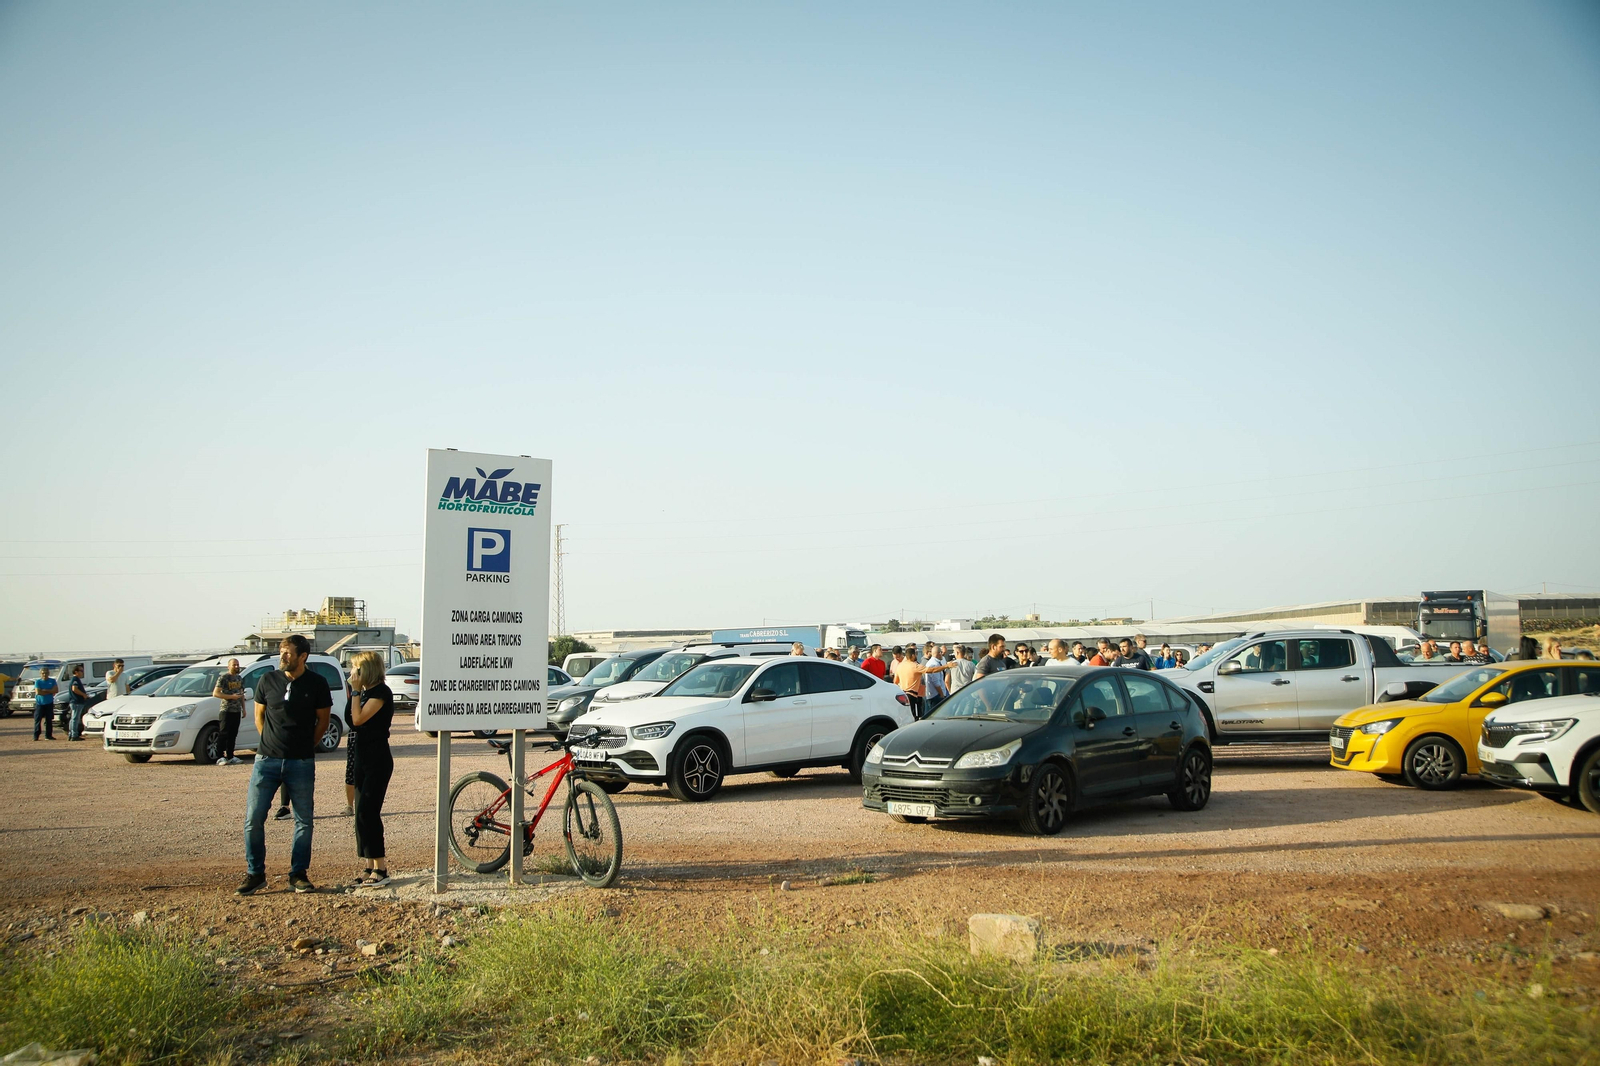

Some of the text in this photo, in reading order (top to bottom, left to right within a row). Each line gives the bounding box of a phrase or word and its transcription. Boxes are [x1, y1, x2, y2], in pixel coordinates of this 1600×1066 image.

[442, 476, 542, 505] MABE
[438, 501, 535, 516] HORTOFRUTICOLA
[472, 530, 505, 569] P
[466, 573, 510, 583] PARKING
[451, 610, 523, 624] ZONA CARGA CAMIONES
[451, 633, 522, 646] LOADING AREA TRUCKS
[749, 630, 779, 638] CABRERIZO
[499, 656, 514, 669] LKW
[430, 680, 541, 692] ZONE DE CHARGEMENT DES CAMIONS
[465, 703, 475, 715] DA
[475, 703, 492, 715] AREA
[493, 702, 542, 715] CARREGAMENTO
[893, 803, 912, 815] 4875
